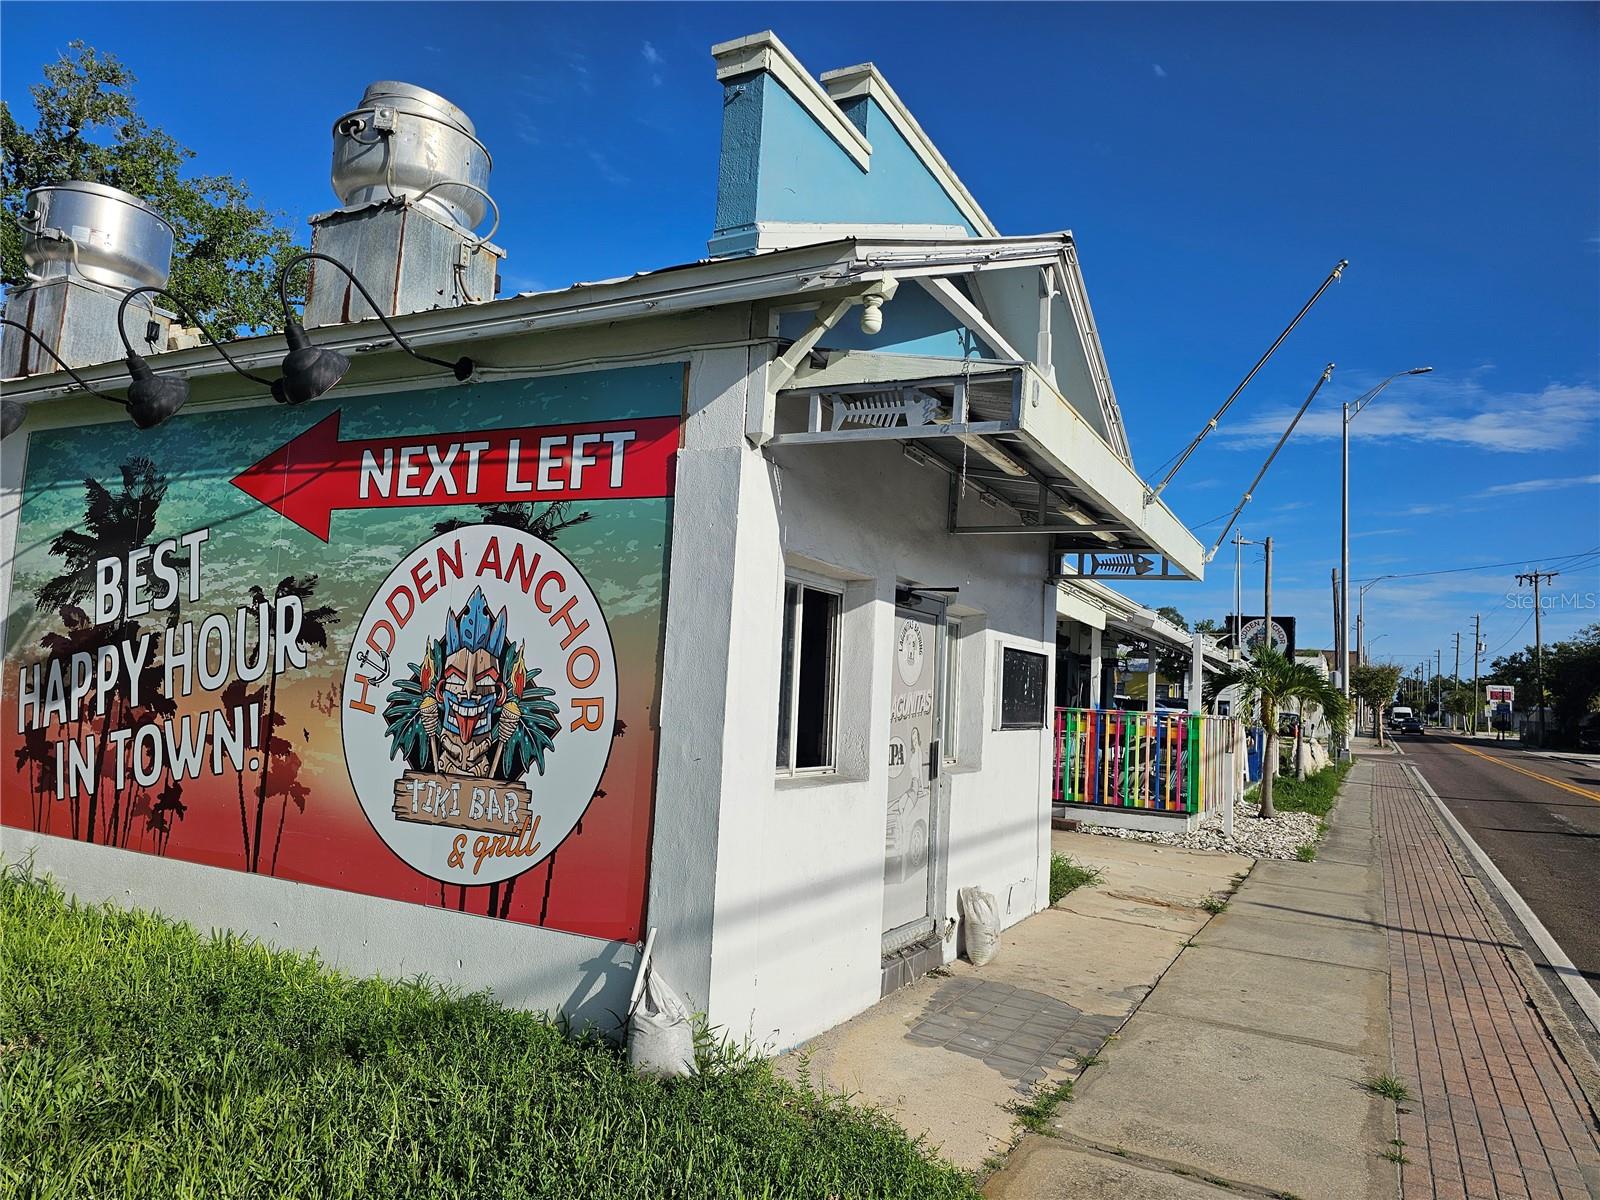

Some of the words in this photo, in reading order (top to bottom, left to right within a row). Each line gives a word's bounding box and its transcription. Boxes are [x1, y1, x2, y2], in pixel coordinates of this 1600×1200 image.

[358, 440, 490, 499] NEXT
[505, 430, 636, 492] LEFT
[94, 527, 209, 626] BEST
[17, 634, 150, 735] HAPPY
[164, 594, 307, 700] HOUR
[475, 536, 605, 733] ANCHOR
[1261, 620, 1286, 645] ACHOR
[890, 689, 932, 723] AGUNITAS
[55, 735, 95, 801] IN
[110, 702, 260, 791] TOWN!
[406, 778, 461, 819] TIKI
[468, 789, 520, 824] BAR
[447, 833, 467, 869] &
[472, 815, 541, 875] grill
